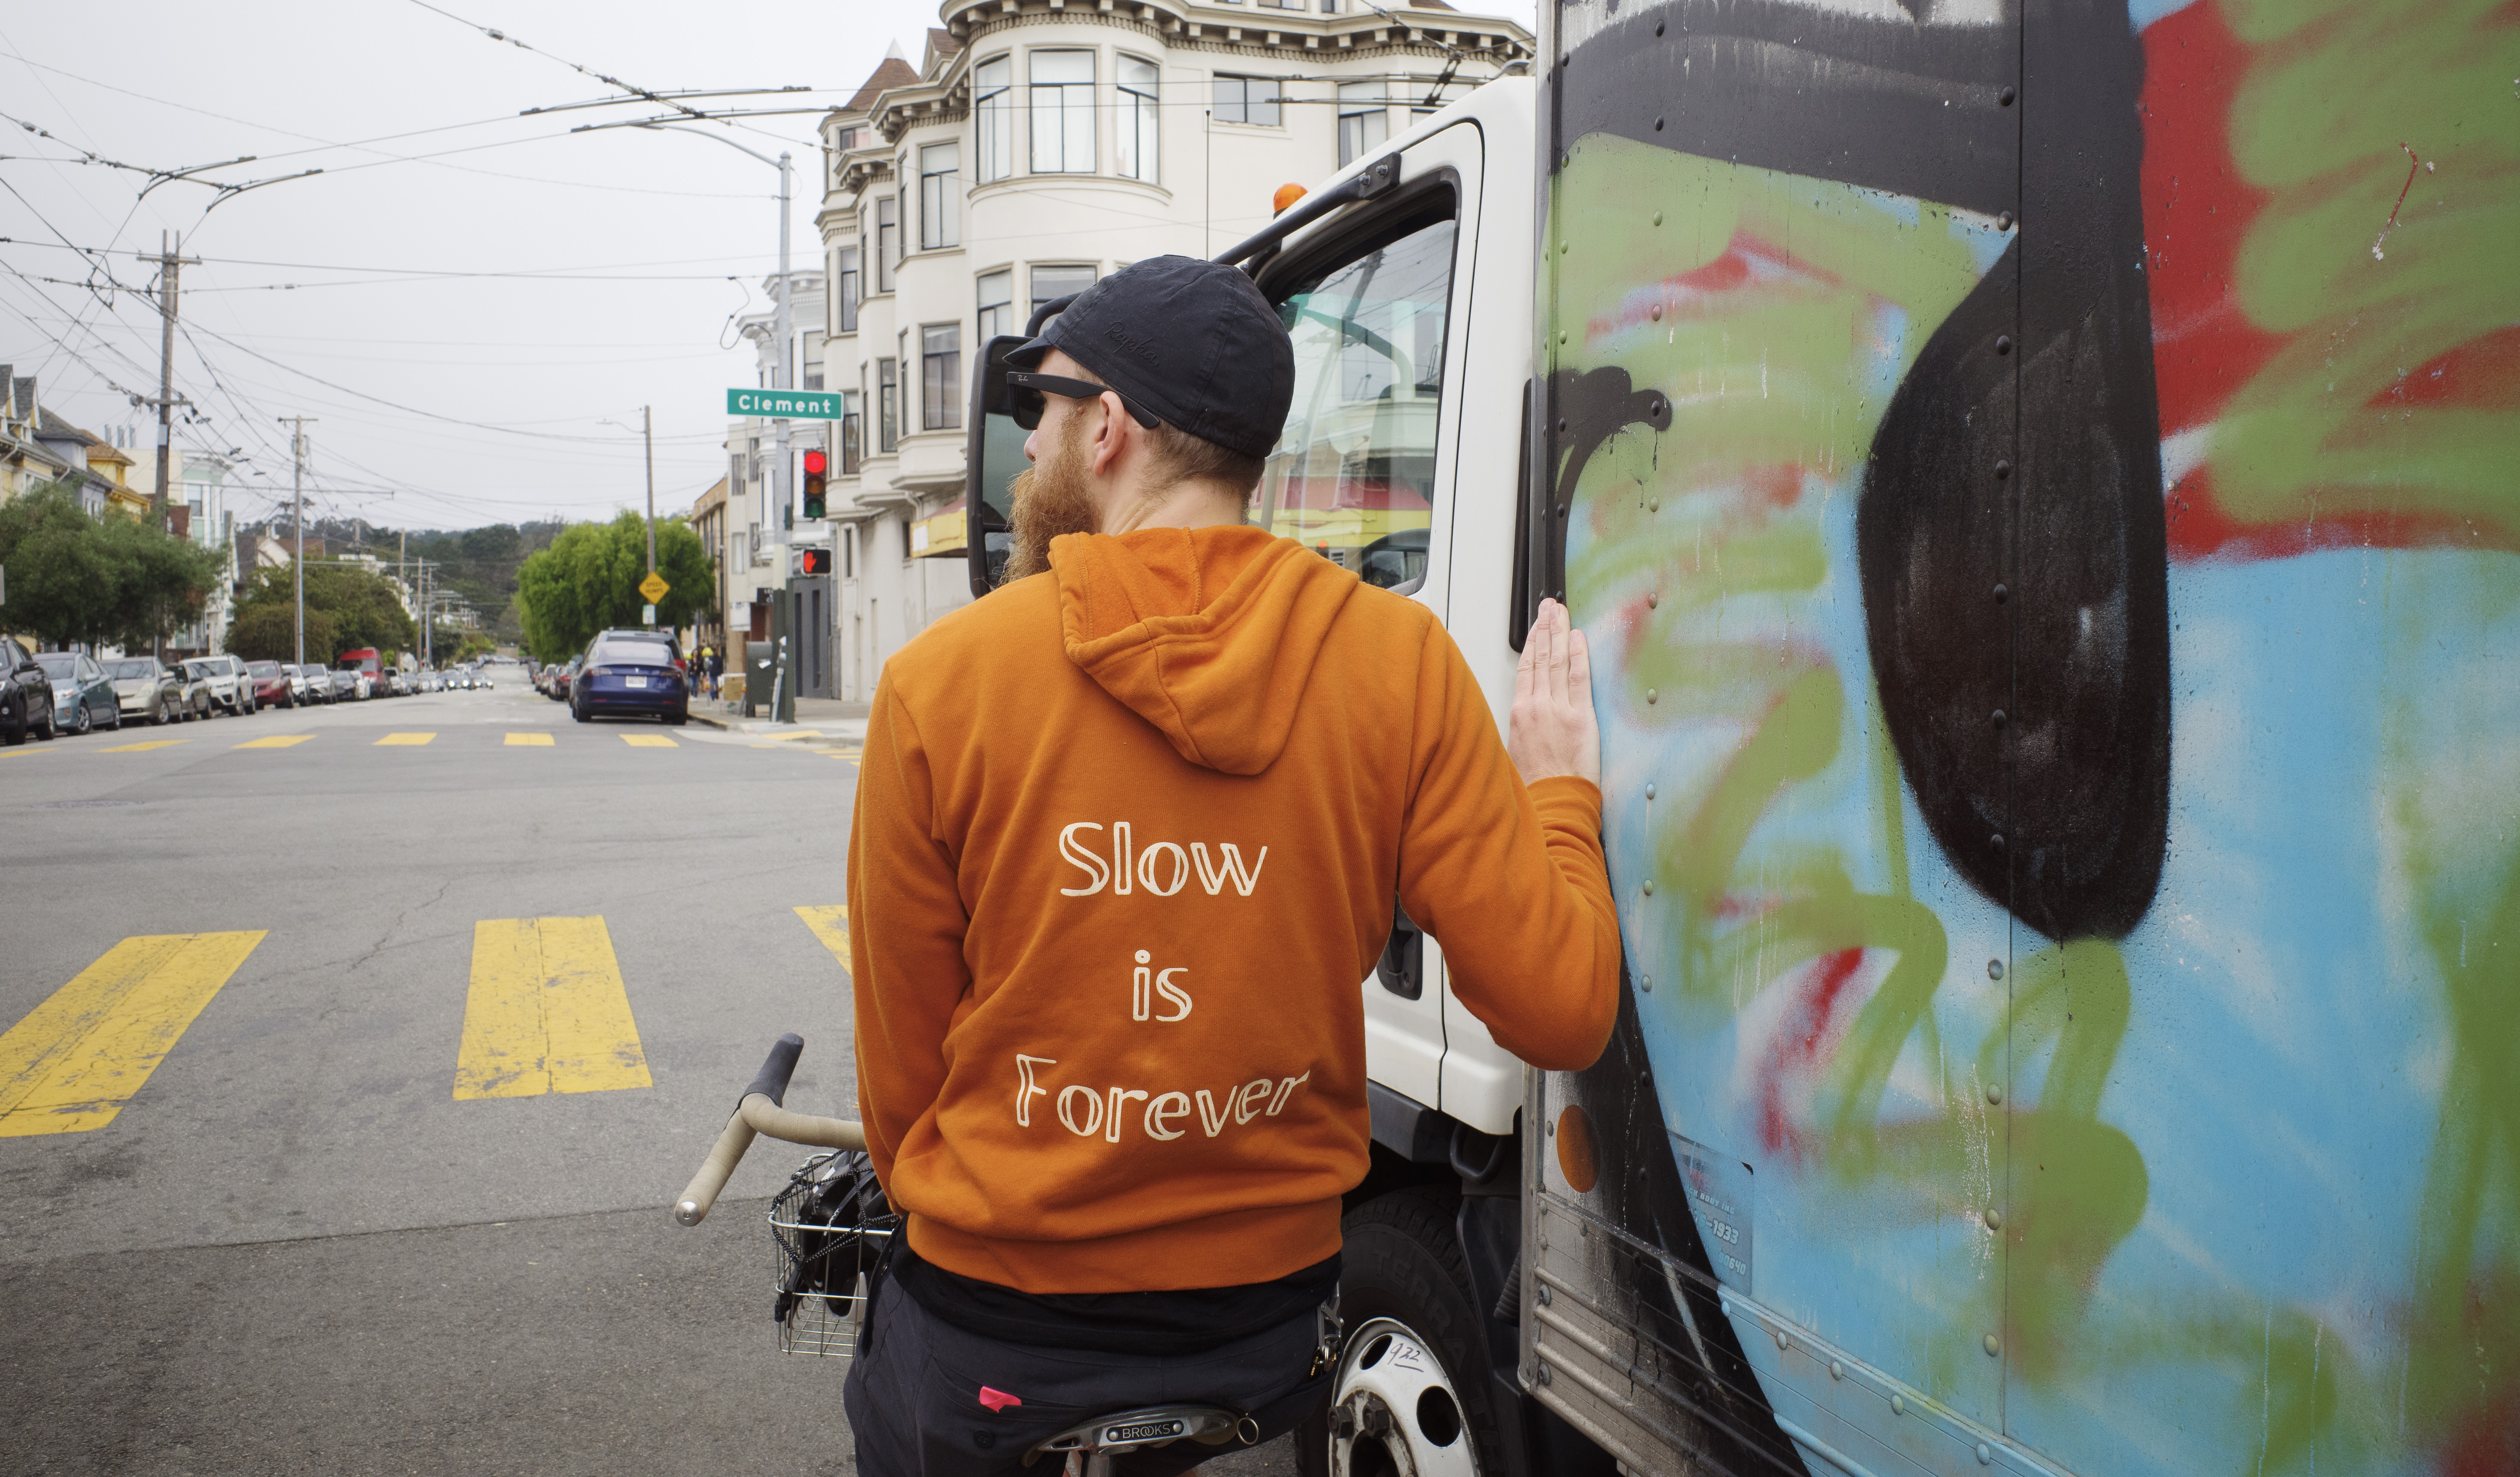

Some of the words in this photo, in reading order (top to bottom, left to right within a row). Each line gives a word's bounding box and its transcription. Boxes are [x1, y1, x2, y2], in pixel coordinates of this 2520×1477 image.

[738, 395, 831, 413] Clement
[1059, 821, 1267, 896] Slow
[1132, 949, 1193, 1022] is
[1016, 1054, 1310, 1143] Forever
[1700, 1192, 1720, 1207] BODY
[1722, 1202, 1735, 1214] INC
[1372, 1247, 1468, 1374] TERRA
[1122, 1423, 1171, 1439] BROOKS
